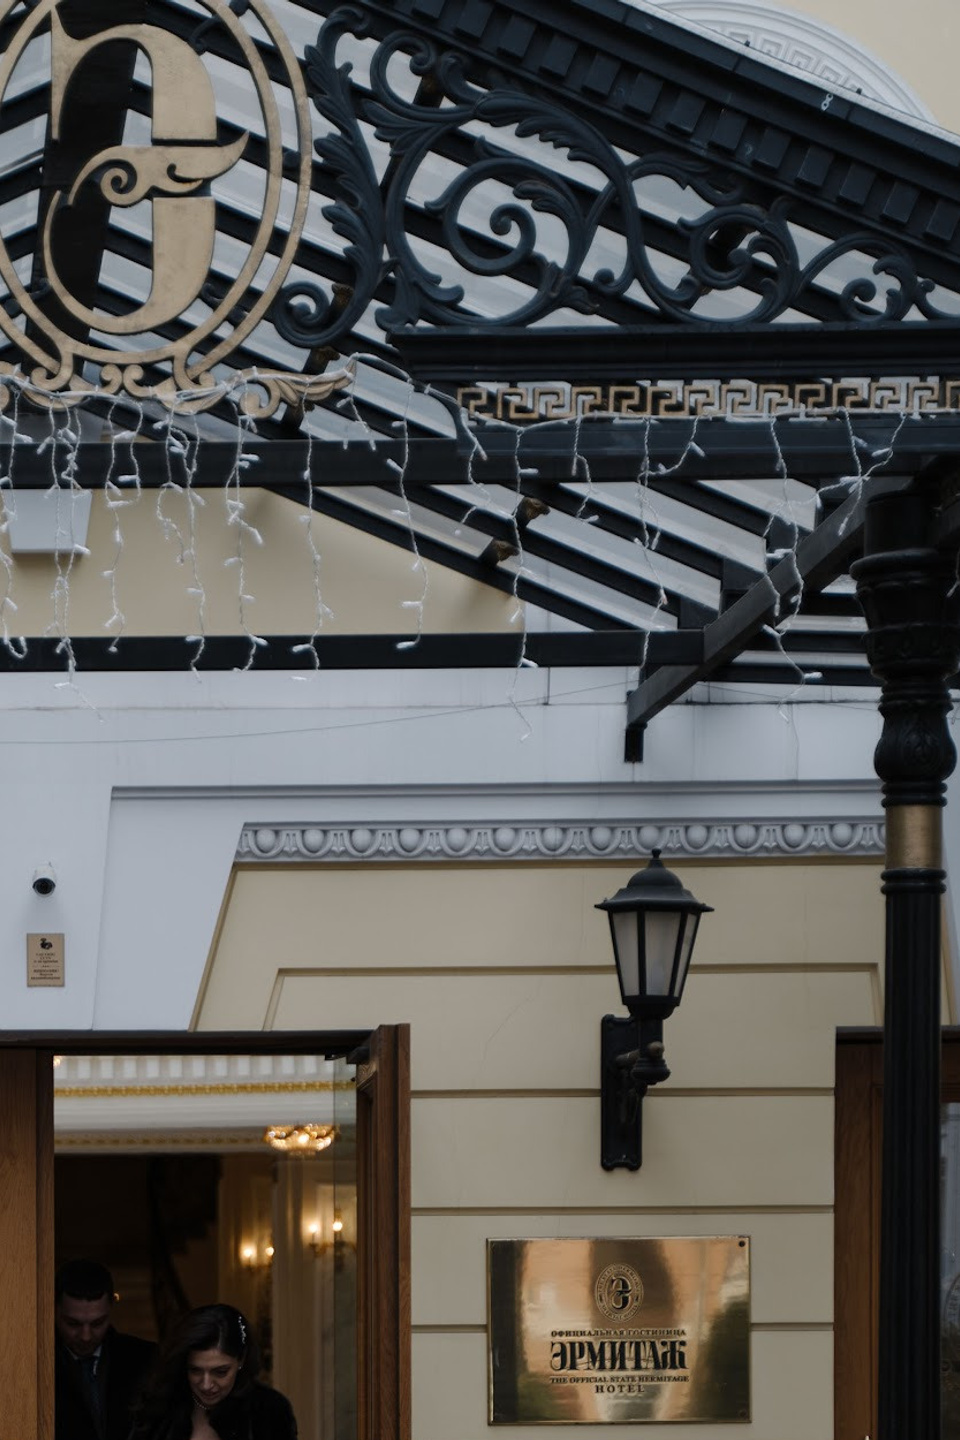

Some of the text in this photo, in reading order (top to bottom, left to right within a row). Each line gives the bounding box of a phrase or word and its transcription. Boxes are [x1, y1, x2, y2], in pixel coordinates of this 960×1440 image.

[551, 1329, 686, 1338] ОФИЦИАЛЬНАЯ ГОСТИНИЦА
[550, 1340, 689, 1371] ЭРМИТАЖ
[638, 1375, 689, 1383] HERMITAGE
[595, 1384, 645, 1394] HOTEL
